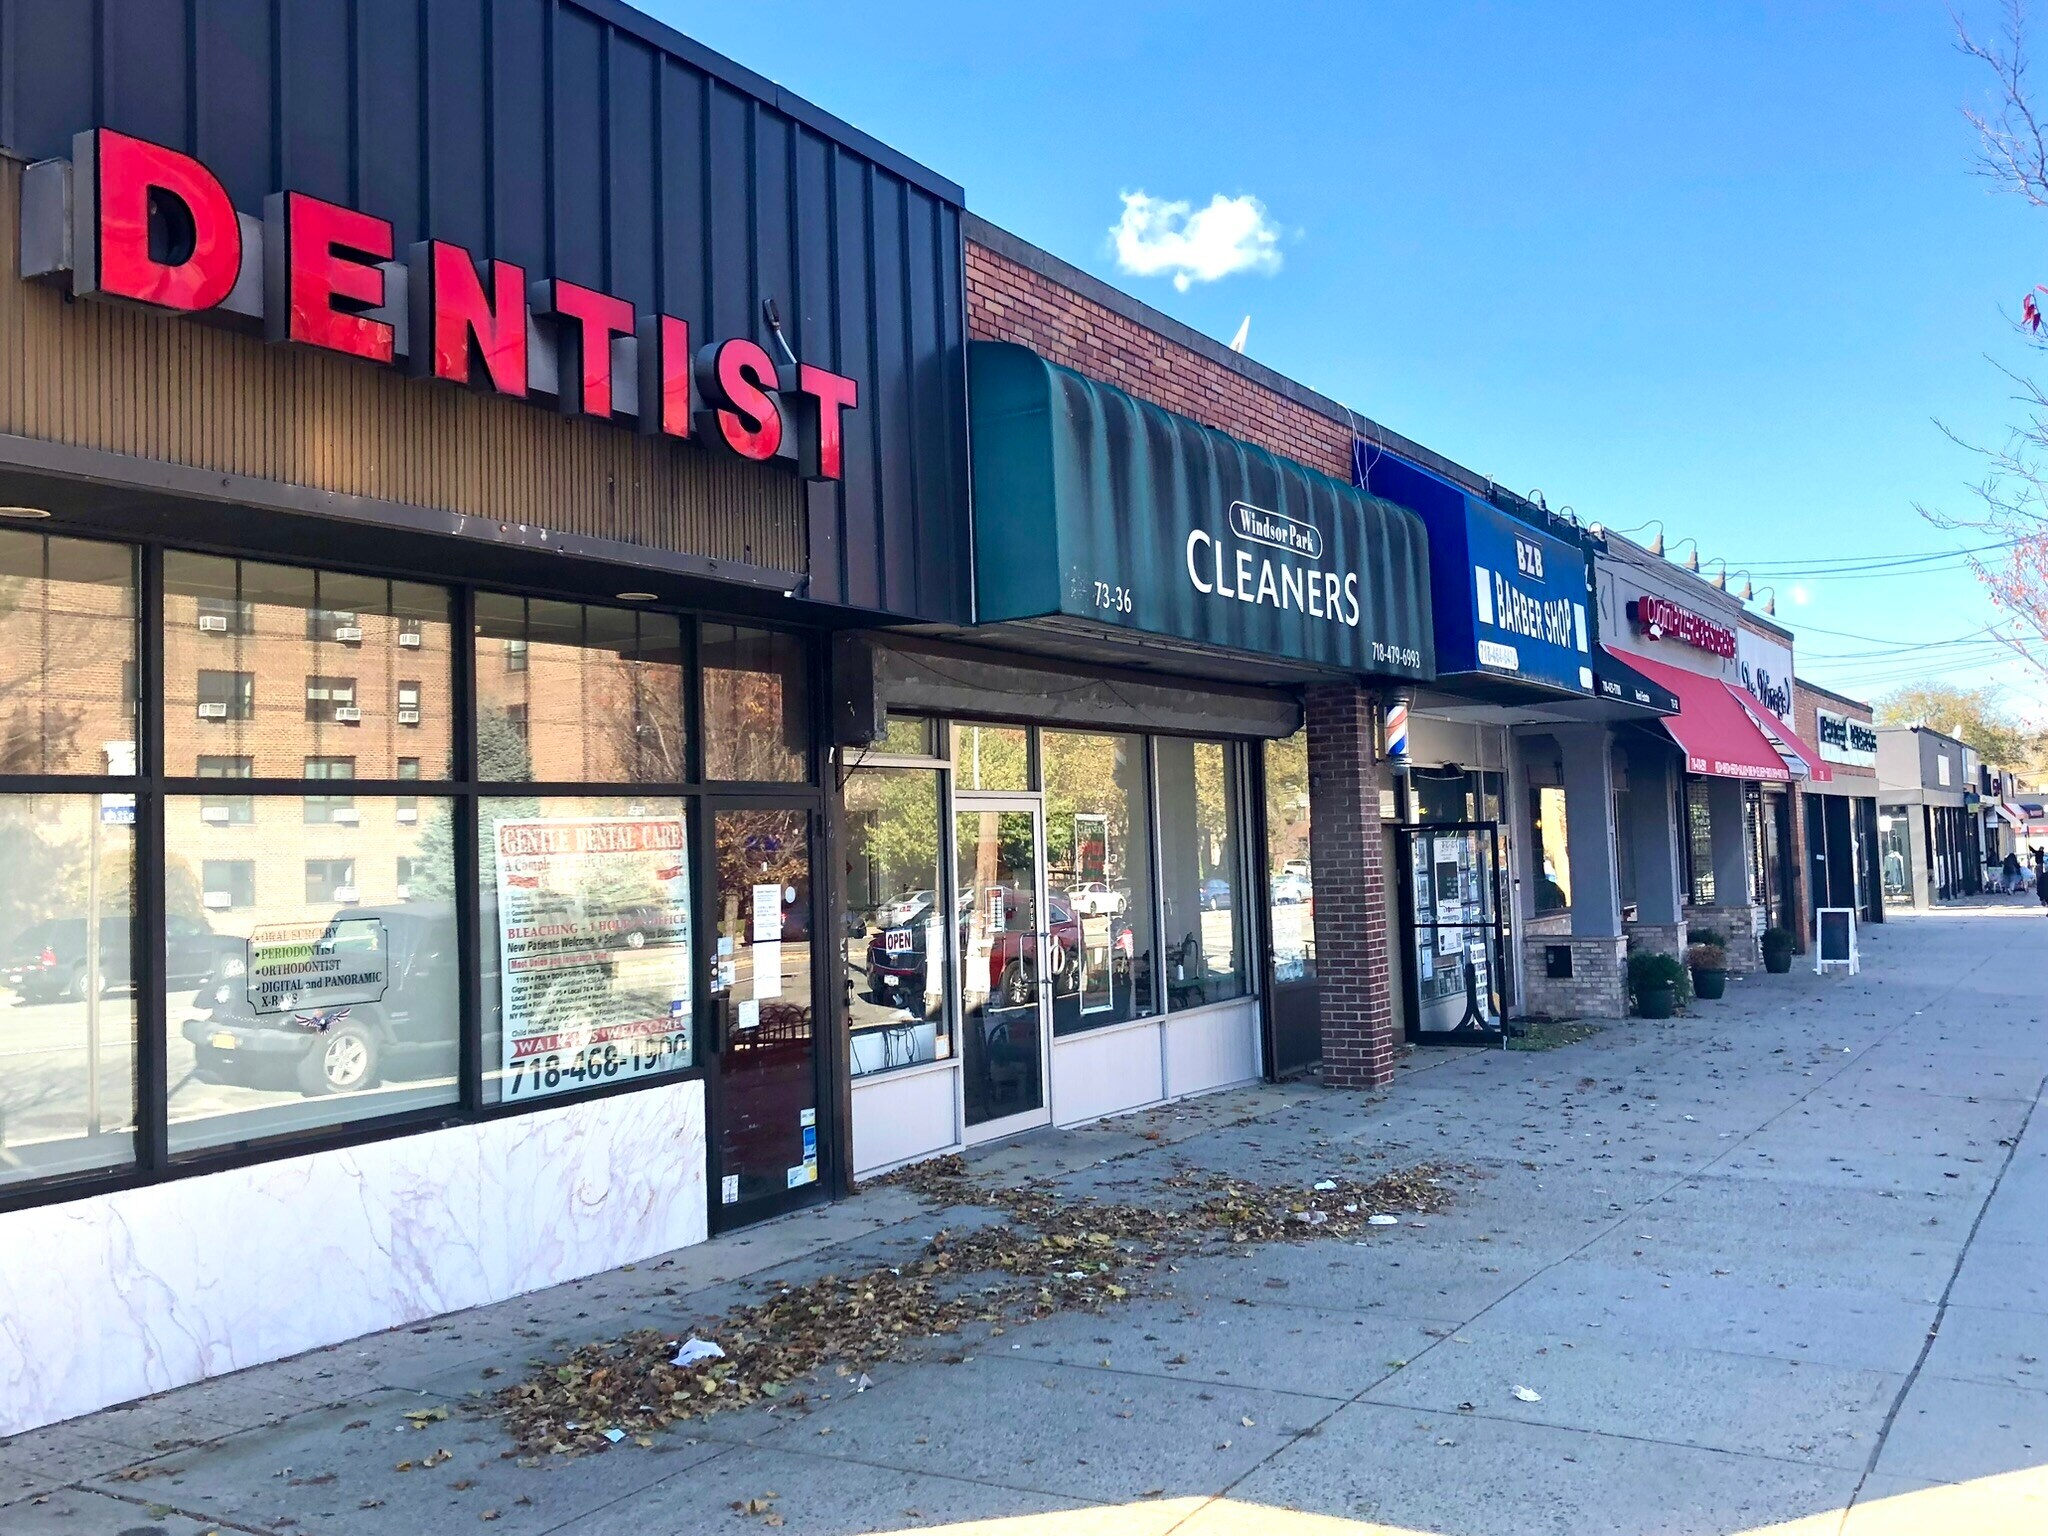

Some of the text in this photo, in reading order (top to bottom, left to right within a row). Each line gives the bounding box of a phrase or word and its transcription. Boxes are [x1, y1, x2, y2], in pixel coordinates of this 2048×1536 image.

[97, 126, 858, 480] DENTIST
[1239, 508, 1314, 553] Windsor Park
[1516, 540, 1543, 577] BZB
[1186, 529, 1360, 627] CLEANERS
[1094, 581, 1132, 613] 73-36
[1495, 570, 1571, 649] BARBER SHOP
[1372, 641, 1420, 668] 718-479-6993
[503, 825, 681, 853] GENTLE DENTAL CARE
[507, 922, 578, 940] BLEACHING
[507, 942, 526, 953] New
[528, 939, 560, 951] Patients
[562, 935, 595, 947] Welcome
[658, 926, 687, 938] Discount
[887, 931, 911, 950] OPEN
[261, 943, 337, 960] PERIODONTIST
[261, 959, 342, 977] ORTHODONTIST
[262, 971, 383, 993] DIGITAL and PANORAMIC
[511, 986, 528, 995] Cigna
[511, 994, 526, 1002] Local
[512, 1003, 528, 1011] Doral
[511, 1029, 527, 1037] Child
[608, 1020, 681, 1038] WELCOME
